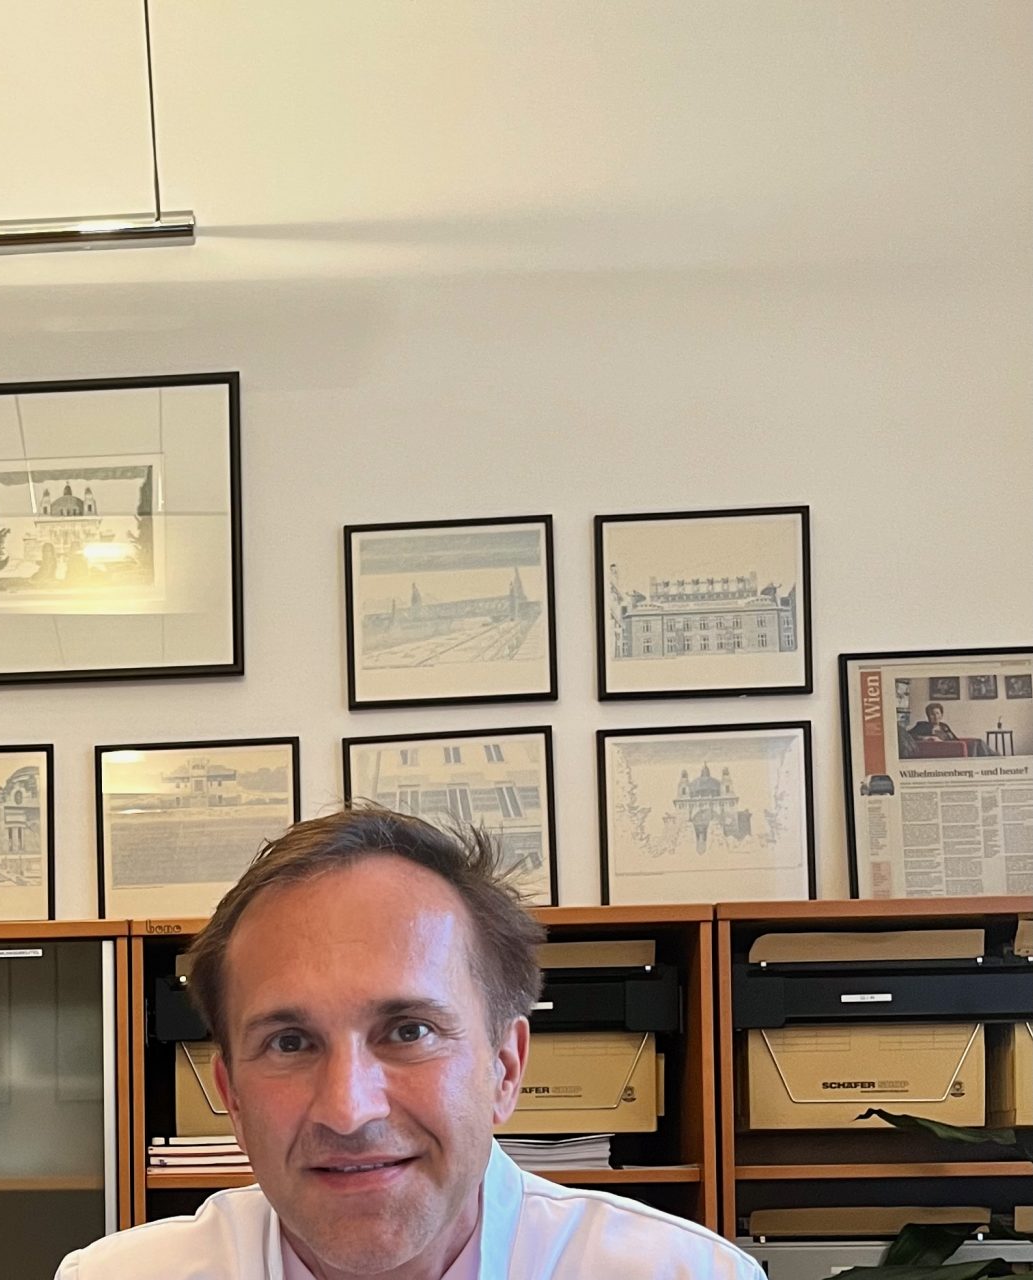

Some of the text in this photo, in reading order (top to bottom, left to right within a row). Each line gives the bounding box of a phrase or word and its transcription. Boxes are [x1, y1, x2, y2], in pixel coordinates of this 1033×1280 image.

[864, 676, 880, 720] Wien
[900, 769, 973, 778] Wilhelminenberg
[981, 768, 998, 776] und
